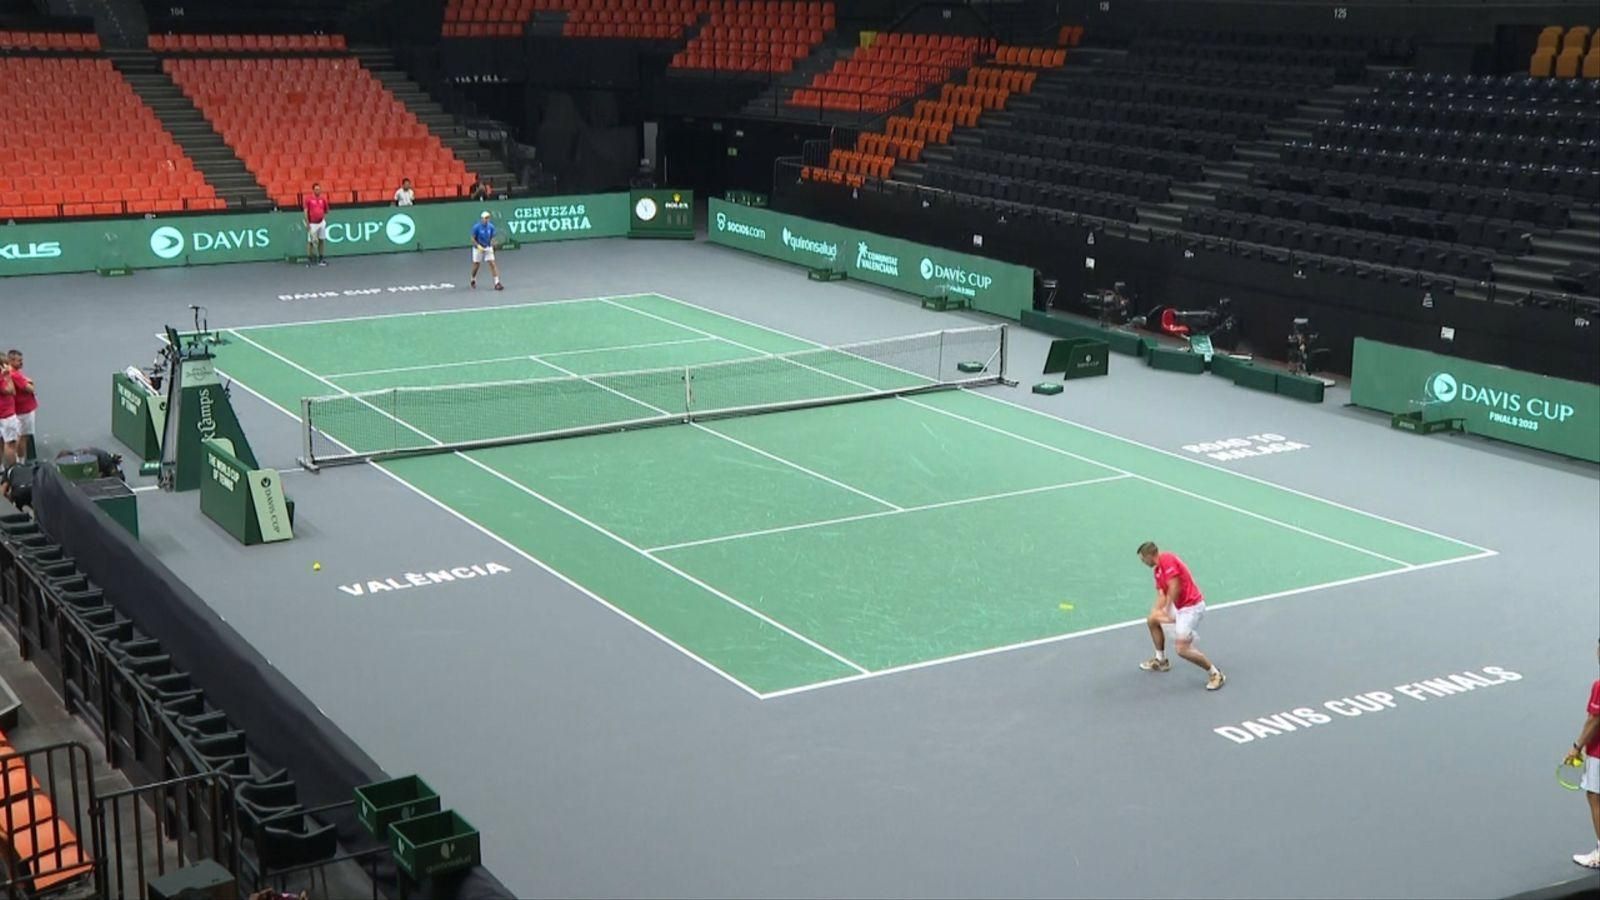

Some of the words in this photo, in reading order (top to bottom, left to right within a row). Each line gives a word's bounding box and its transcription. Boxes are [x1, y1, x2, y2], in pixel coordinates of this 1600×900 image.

[514, 205, 586, 219] CERVEZAS
[508, 216, 592, 234] VICTORIA
[193, 229, 270, 251] DAVIS
[935, 265, 966, 283] DAVIS
[968, 273, 992, 290] CUP
[1461, 383, 1521, 412] DAVIS
[1526, 398, 1575, 422] CUP
[1489, 411, 1518, 426] FINALS
[1518, 418, 1538, 431] 2023
[338, 562, 511, 596] VALÈNCIA
[1213, 707, 1332, 744] DAVIS
[1323, 691, 1397, 717] CUP
[1395, 666, 1524, 701] FINALS
